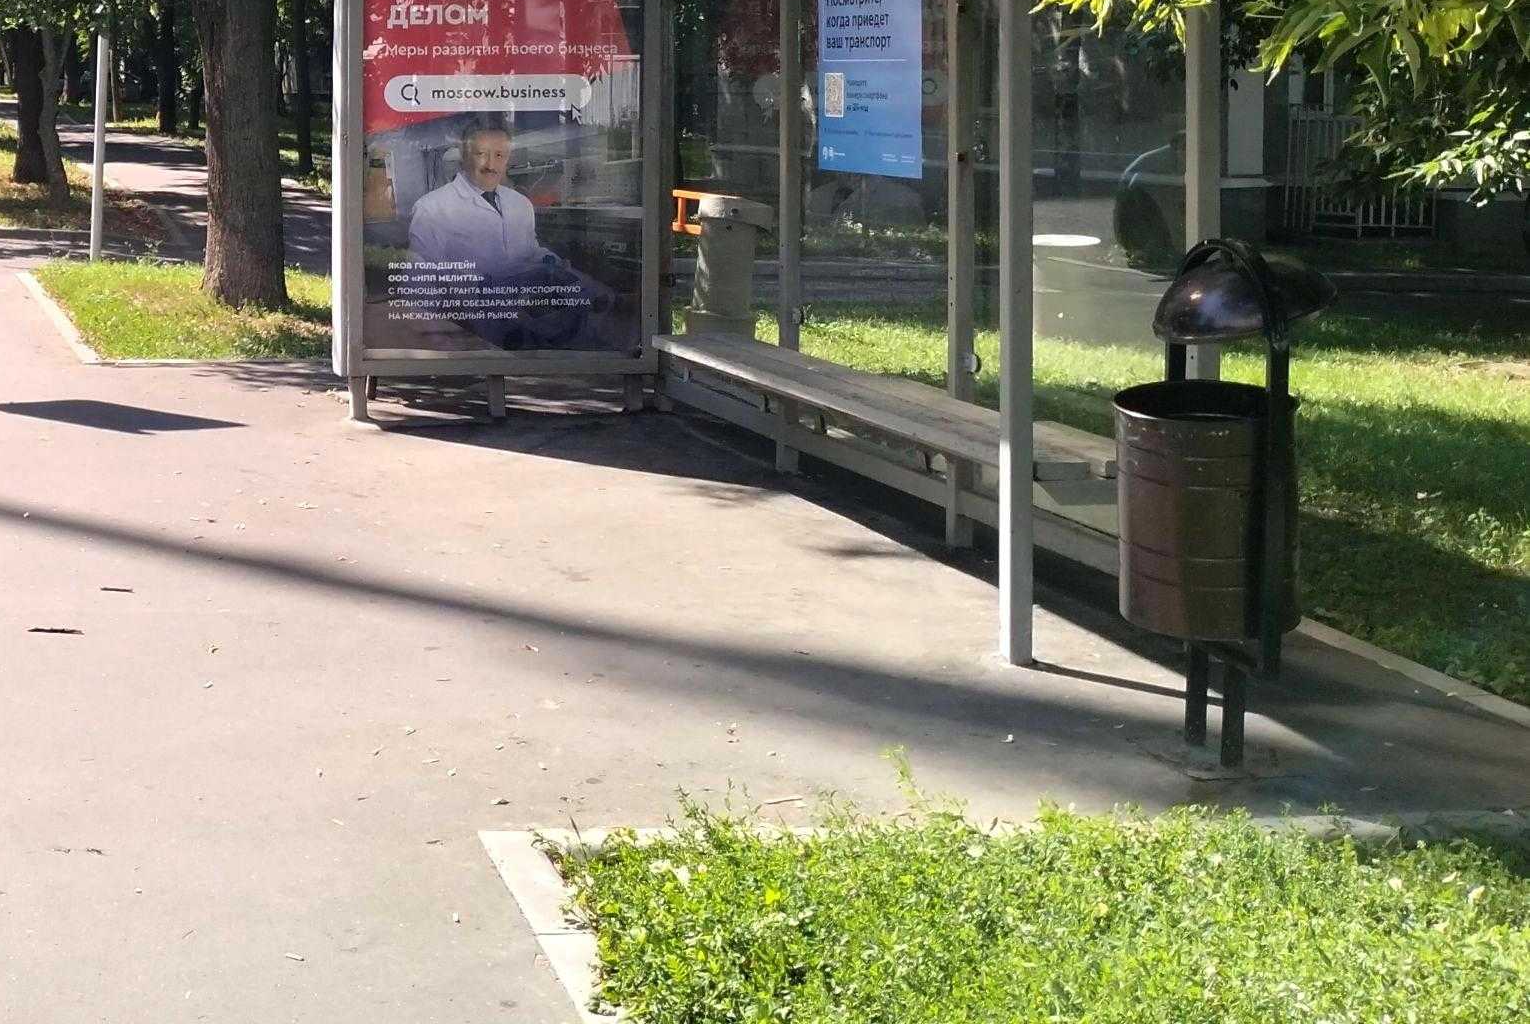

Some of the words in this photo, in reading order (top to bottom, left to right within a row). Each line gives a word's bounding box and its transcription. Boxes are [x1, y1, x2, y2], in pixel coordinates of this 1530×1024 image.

[386, 4, 489, 29] ДЕЛОМ
[826, 15, 850, 29] когда
[852, 13, 889, 30] приедет
[385, 44, 428, 58] Меры
[432, 45, 499, 58] развития
[503, 44, 554, 55] твоего
[558, 41, 618, 55] бизнеса
[826, 37, 843, 49] ваш
[845, 36, 892, 52] транспорт
[431, 84, 566, 100] moscow.business
[388, 262, 412, 270] ЯКОВ
[414, 260, 476, 271] ГОЛЬДШТЕЙН
[388, 287, 395, 295] С
[396, 287, 447, 295] ПОМОЩЬЮ
[449, 287, 481, 295] ГРАНТА
[482, 286, 518, 294] ВЫВЕЛИ
[520, 286, 581, 294] ЭКСПОРТНУЮ
[388, 300, 440, 308] УСТАНОВКУ
[442, 300, 460, 308] ДЛЯ
[462, 299, 549, 307] ОБЕЗЗАРАЖИВАНИЯ
[551, 298, 591, 307] ВОЗДУХА
[388, 312, 400, 320] НА
[402, 311, 485, 321] МЕЖДУНАРОДНЫЙ
[487, 312, 519, 320] РЫНОК
